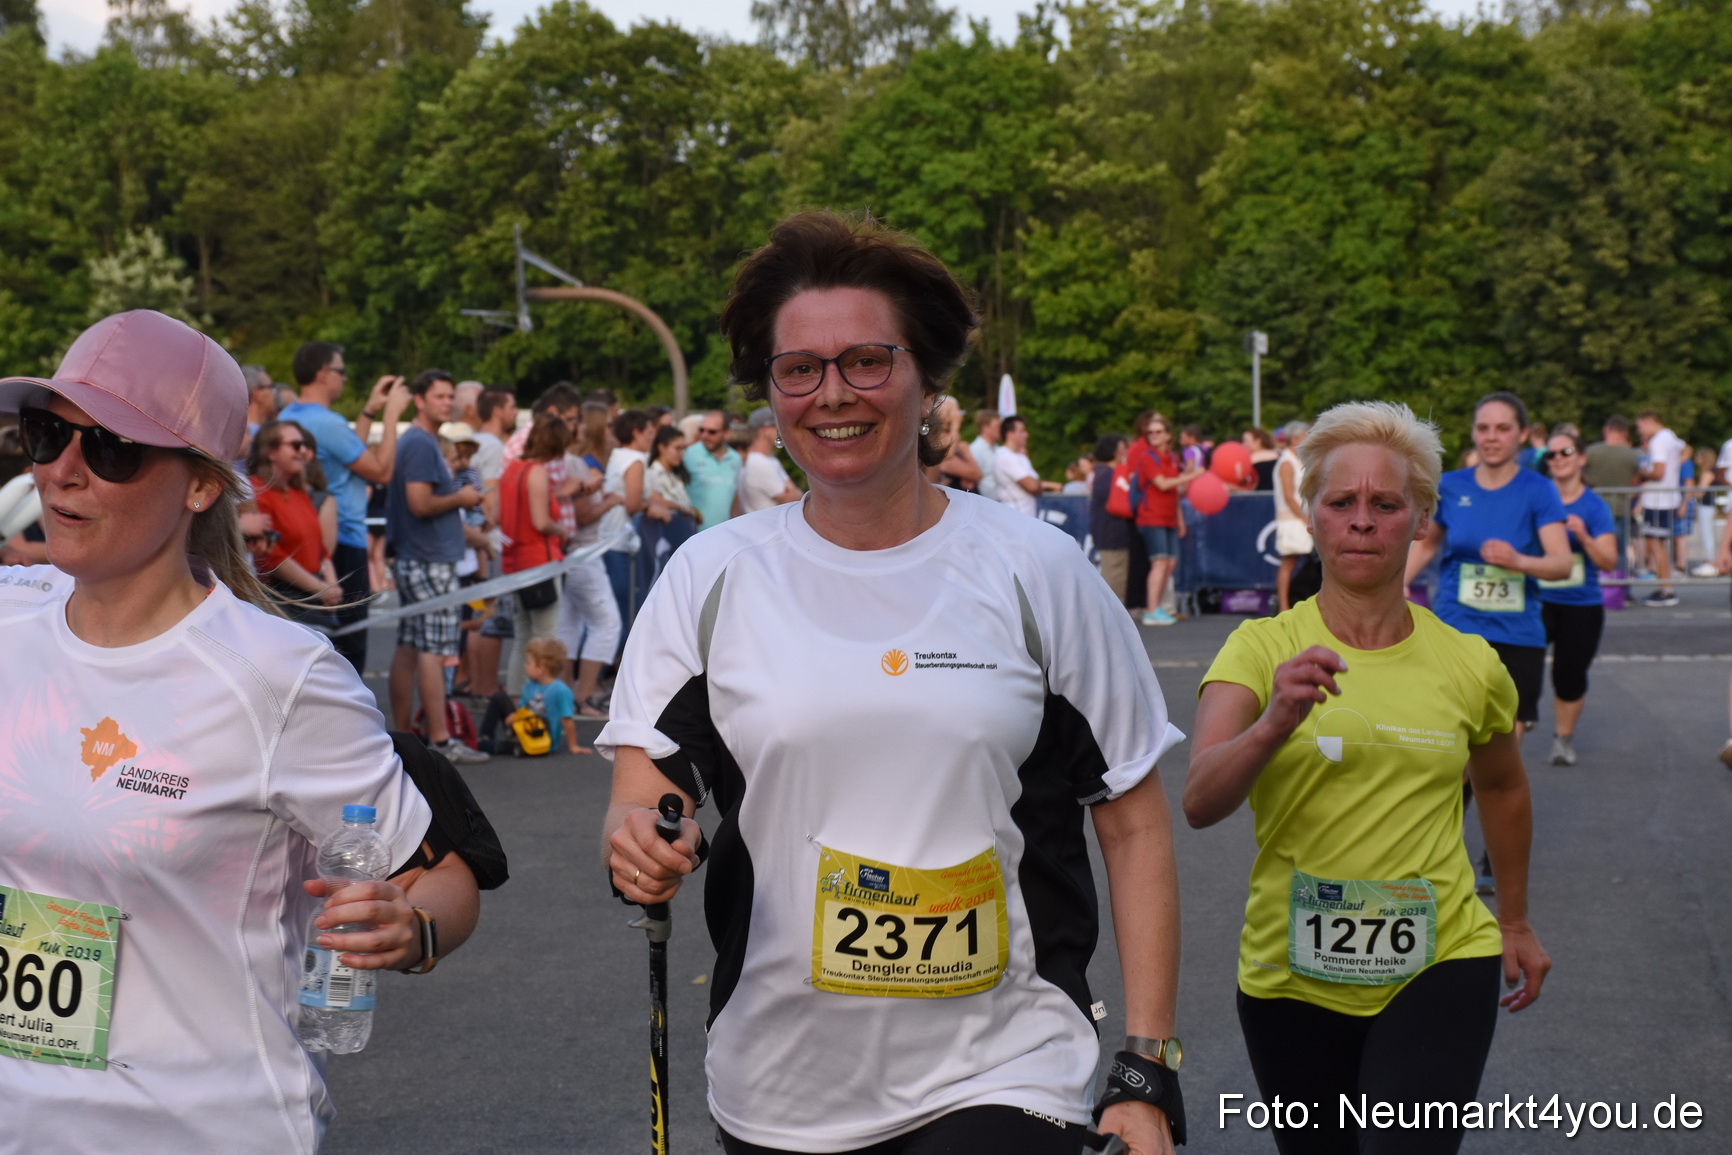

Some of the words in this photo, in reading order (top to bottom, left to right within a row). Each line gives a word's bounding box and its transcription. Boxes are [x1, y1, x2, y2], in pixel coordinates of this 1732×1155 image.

[14, 578, 53, 592] JAKO
[1473, 581, 1510, 598] 573
[914, 651, 957, 660] Treukontax
[1375, 723, 1407, 733] Kliniken
[1408, 727, 1420, 735] des
[1399, 735, 1435, 744] Neumarkt
[92, 740, 116, 757] NM
[120, 765, 190, 788] LANDKREIS
[116, 777, 187, 800] NEUMARKT
[844, 881, 920, 907] firmenlauf
[928, 896, 963, 914] walk
[965, 887, 995, 908] 2019
[1307, 894, 1367, 911] firmenlauf
[1399, 906, 1427, 917] 2019
[835, 907, 978, 961] 2371
[1306, 913, 1416, 955] 1276
[65, 944, 102, 962] 2019
[1314, 951, 1372, 966] Pommerer
[1375, 957, 1407, 966] Heike
[822, 967, 865, 981] Treukontax
[867, 970, 982, 985] Steuerberatungsgesellschaft
[983, 964, 1000, 974] mbH
[852, 959, 912, 977] Dengler
[916, 960, 973, 975] Claudia
[1323, 964, 1357, 974] Klinikum
[1358, 966, 1396, 975] Neumarkt
[18, 1015, 53, 1034] Julia
